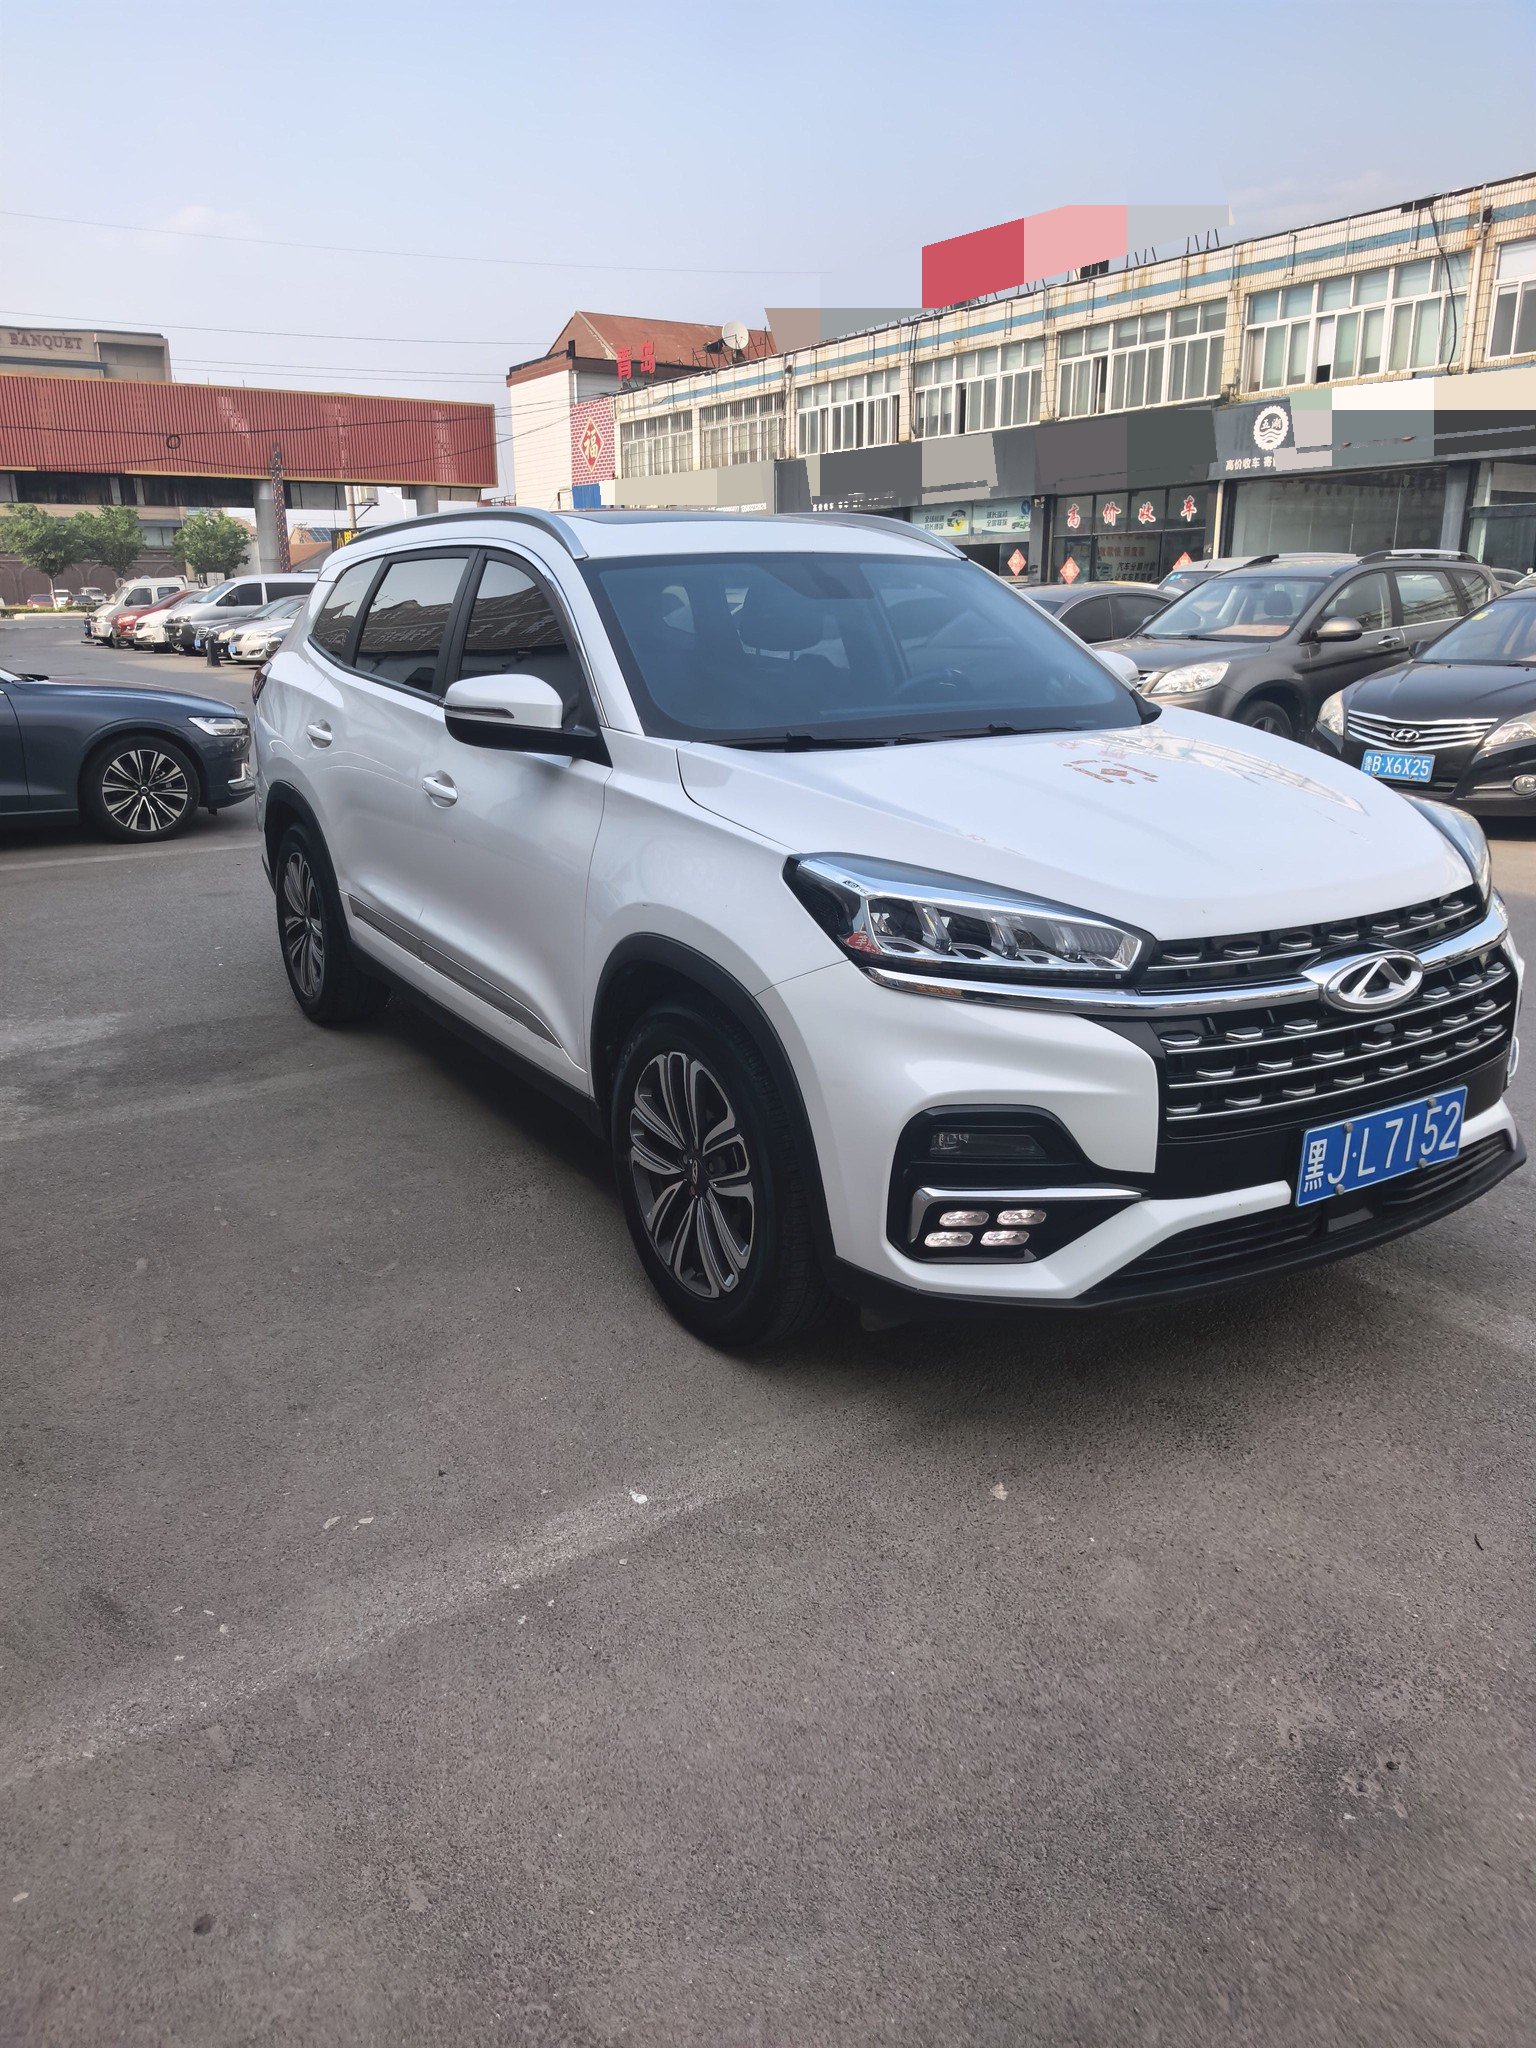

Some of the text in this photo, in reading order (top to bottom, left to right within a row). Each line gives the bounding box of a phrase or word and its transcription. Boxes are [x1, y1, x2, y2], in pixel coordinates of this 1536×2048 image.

[9, 332, 82, 350] BANQUET
[616, 340, 656, 381] 青岛
[583, 428, 599, 459] 福
[1225, 456, 1261, 472] 高价收车
[1067, 495, 1198, 529] 高价收车
